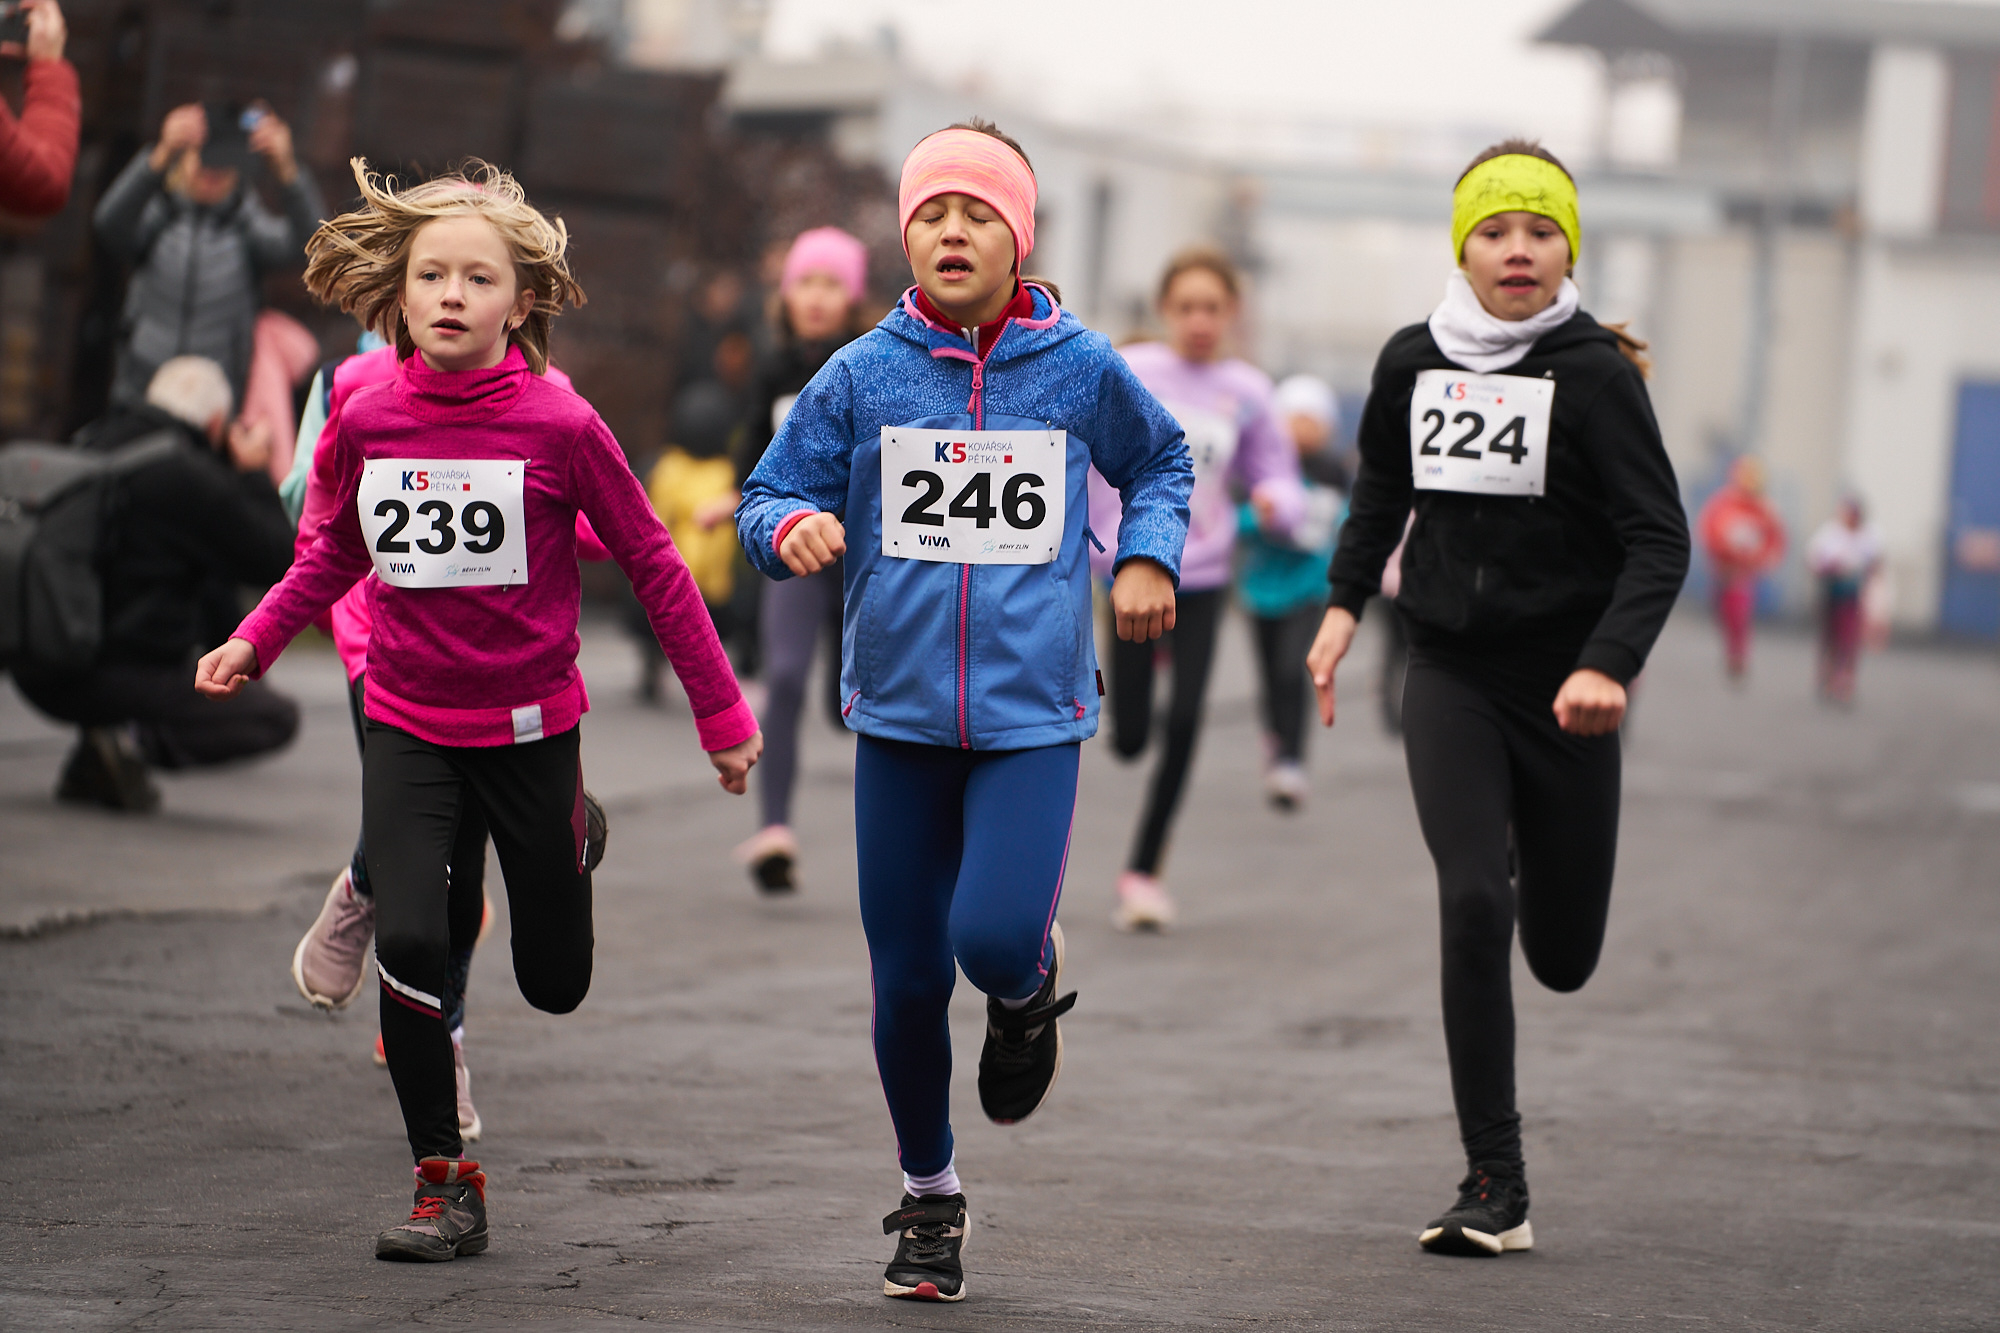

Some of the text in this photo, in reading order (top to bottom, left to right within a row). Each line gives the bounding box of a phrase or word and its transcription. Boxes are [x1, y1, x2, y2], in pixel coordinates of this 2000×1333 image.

[1443, 382, 1467, 401] K5
[934, 441, 967, 463] K5
[1420, 408, 1529, 465] 224
[401, 470, 429, 491] K5
[901, 470, 1046, 530] 246
[373, 499, 505, 555] 239
